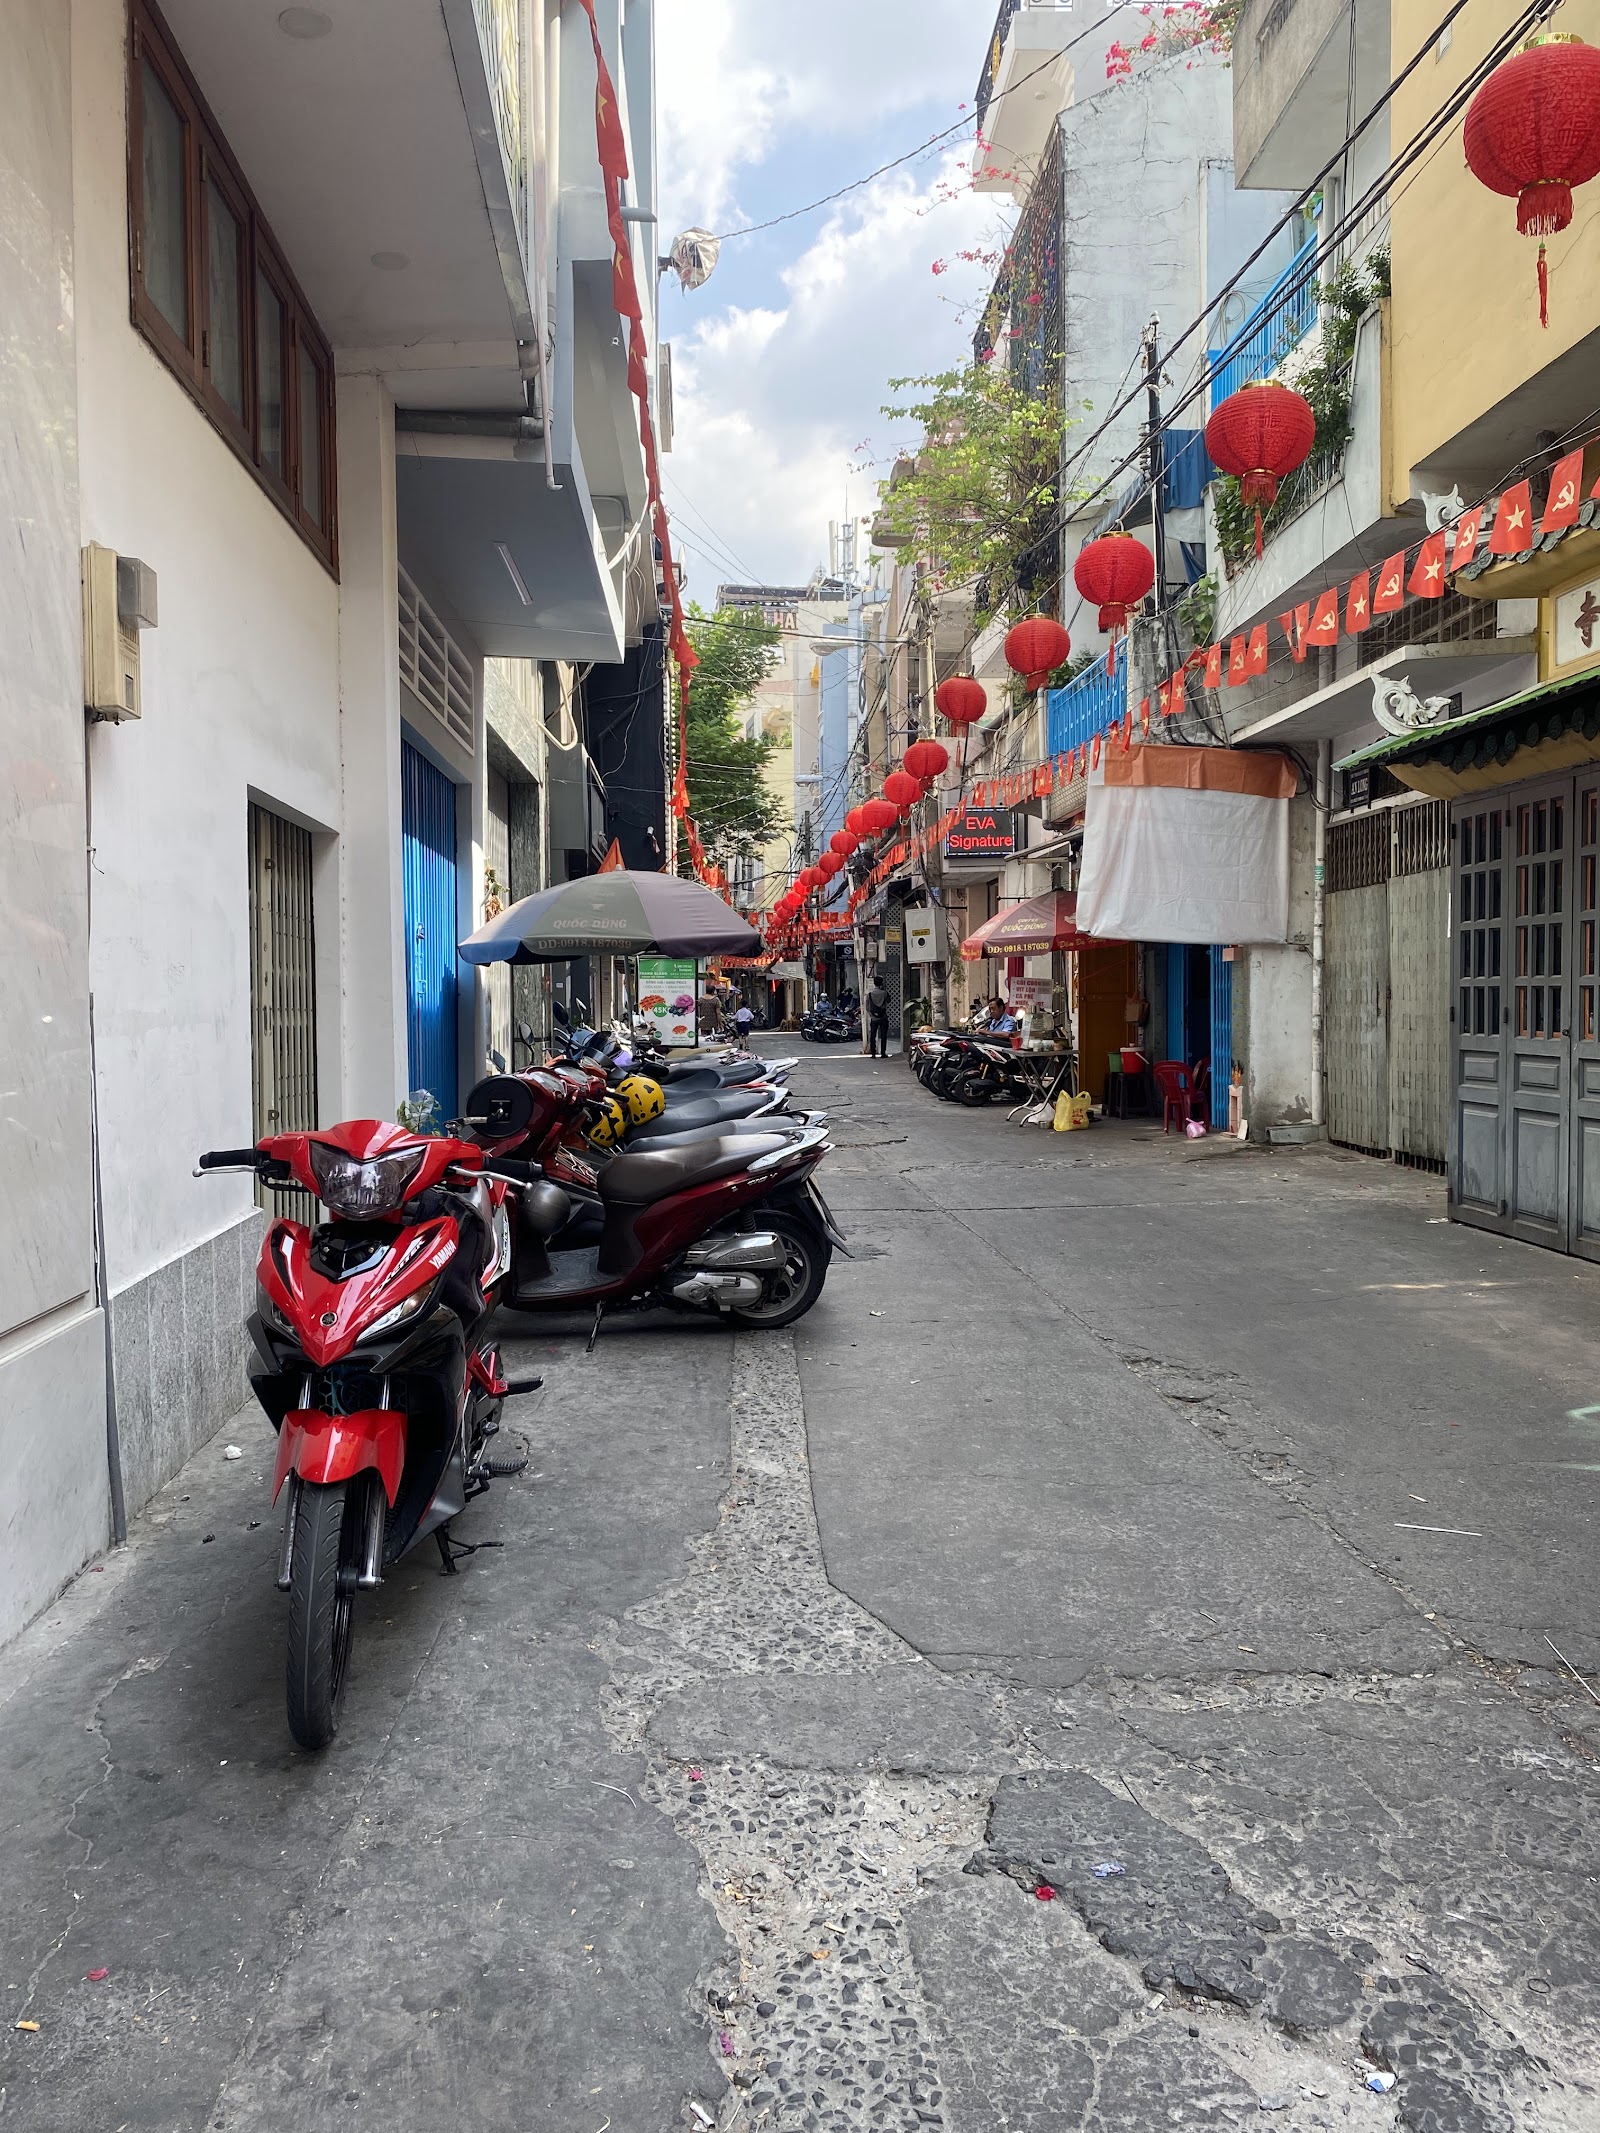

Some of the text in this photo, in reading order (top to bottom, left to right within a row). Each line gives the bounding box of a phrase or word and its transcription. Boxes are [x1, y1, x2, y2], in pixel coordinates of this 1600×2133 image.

[966, 816, 997, 830] EVA
[949, 834, 1013, 850] Signature
[1003, 942, 1050, 952] 0918.187039
[653, 1006, 667, 1014] 45K
[428, 1239, 457, 1270] YAMAHA
